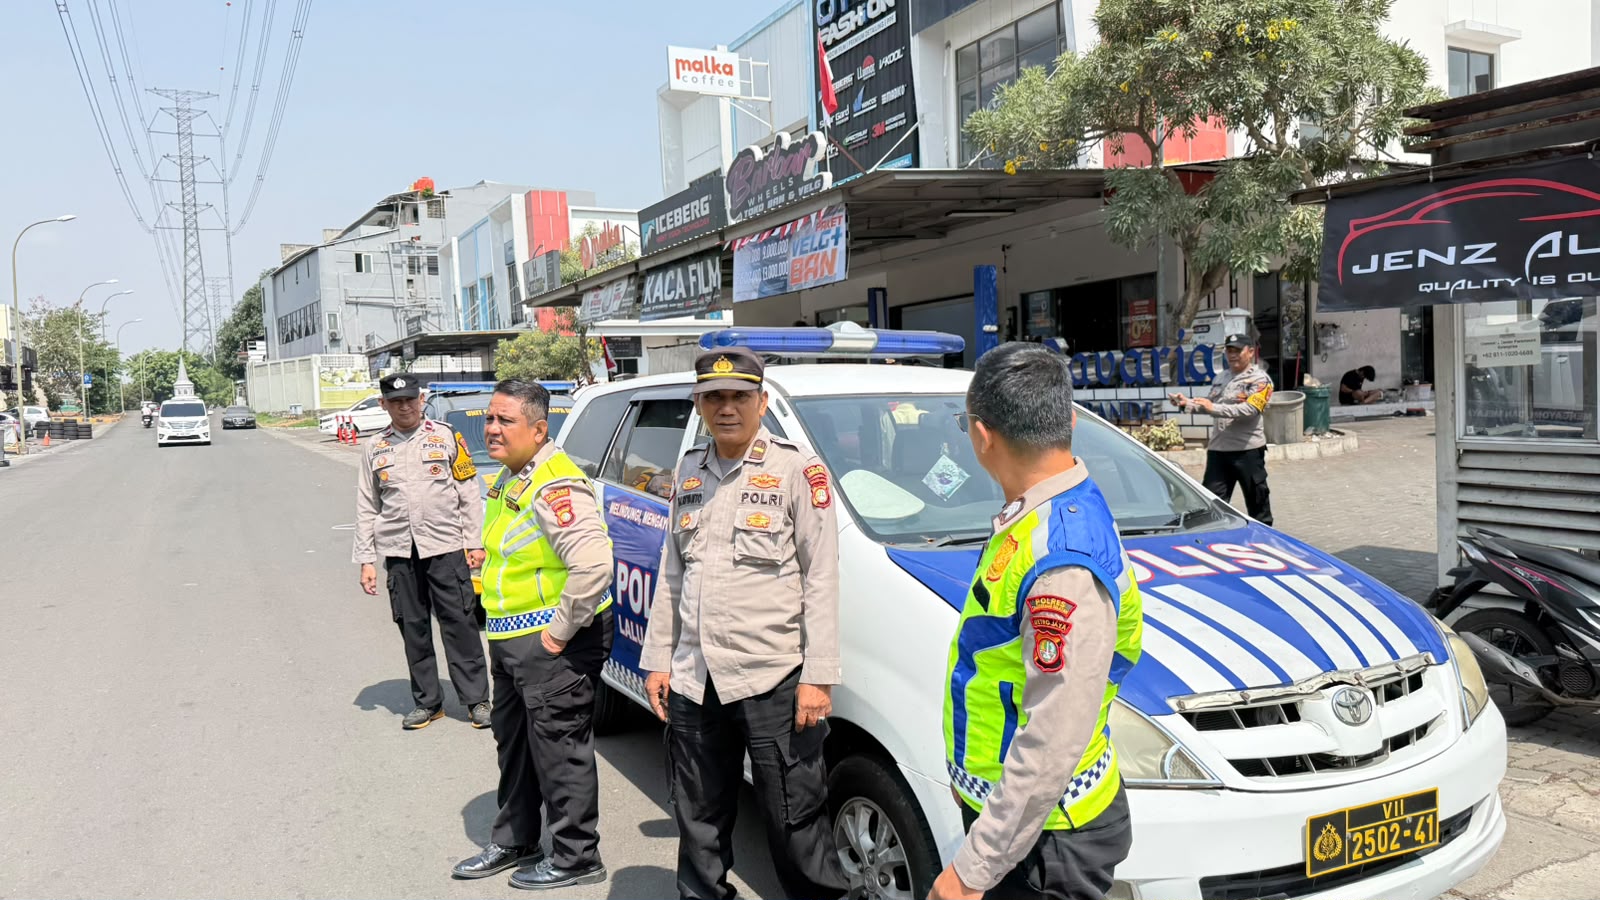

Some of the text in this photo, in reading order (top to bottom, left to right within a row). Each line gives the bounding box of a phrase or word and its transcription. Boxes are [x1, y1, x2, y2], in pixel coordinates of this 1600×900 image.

[675, 55, 734, 80] malka
[682, 74, 735, 88] coffee
[872, 121, 886, 139] 3M
[744, 203, 765, 218] TOKO
[798, 179, 821, 196] VELG
[748, 177, 794, 207] WHEELS
[655, 194, 710, 236] ICEBERG
[790, 247, 838, 287] BAN
[1352, 242, 1497, 275] JENZ
[643, 268, 687, 305] KACA
[688, 256, 721, 297] FILM
[1419, 277, 1522, 299] QUALITY
[1532, 274, 1556, 286] IS
[1044, 328, 1217, 386] avaria
[466, 409, 483, 417] UNIT
[741, 492, 783, 506] POLRI
[1034, 597, 1067, 608] POLRES
[617, 613, 645, 646] LALU
[1050, 620, 1067, 632] JAYA
[1382, 799, 1405, 819] VII
[1352, 814, 1434, 861] 2502-41
